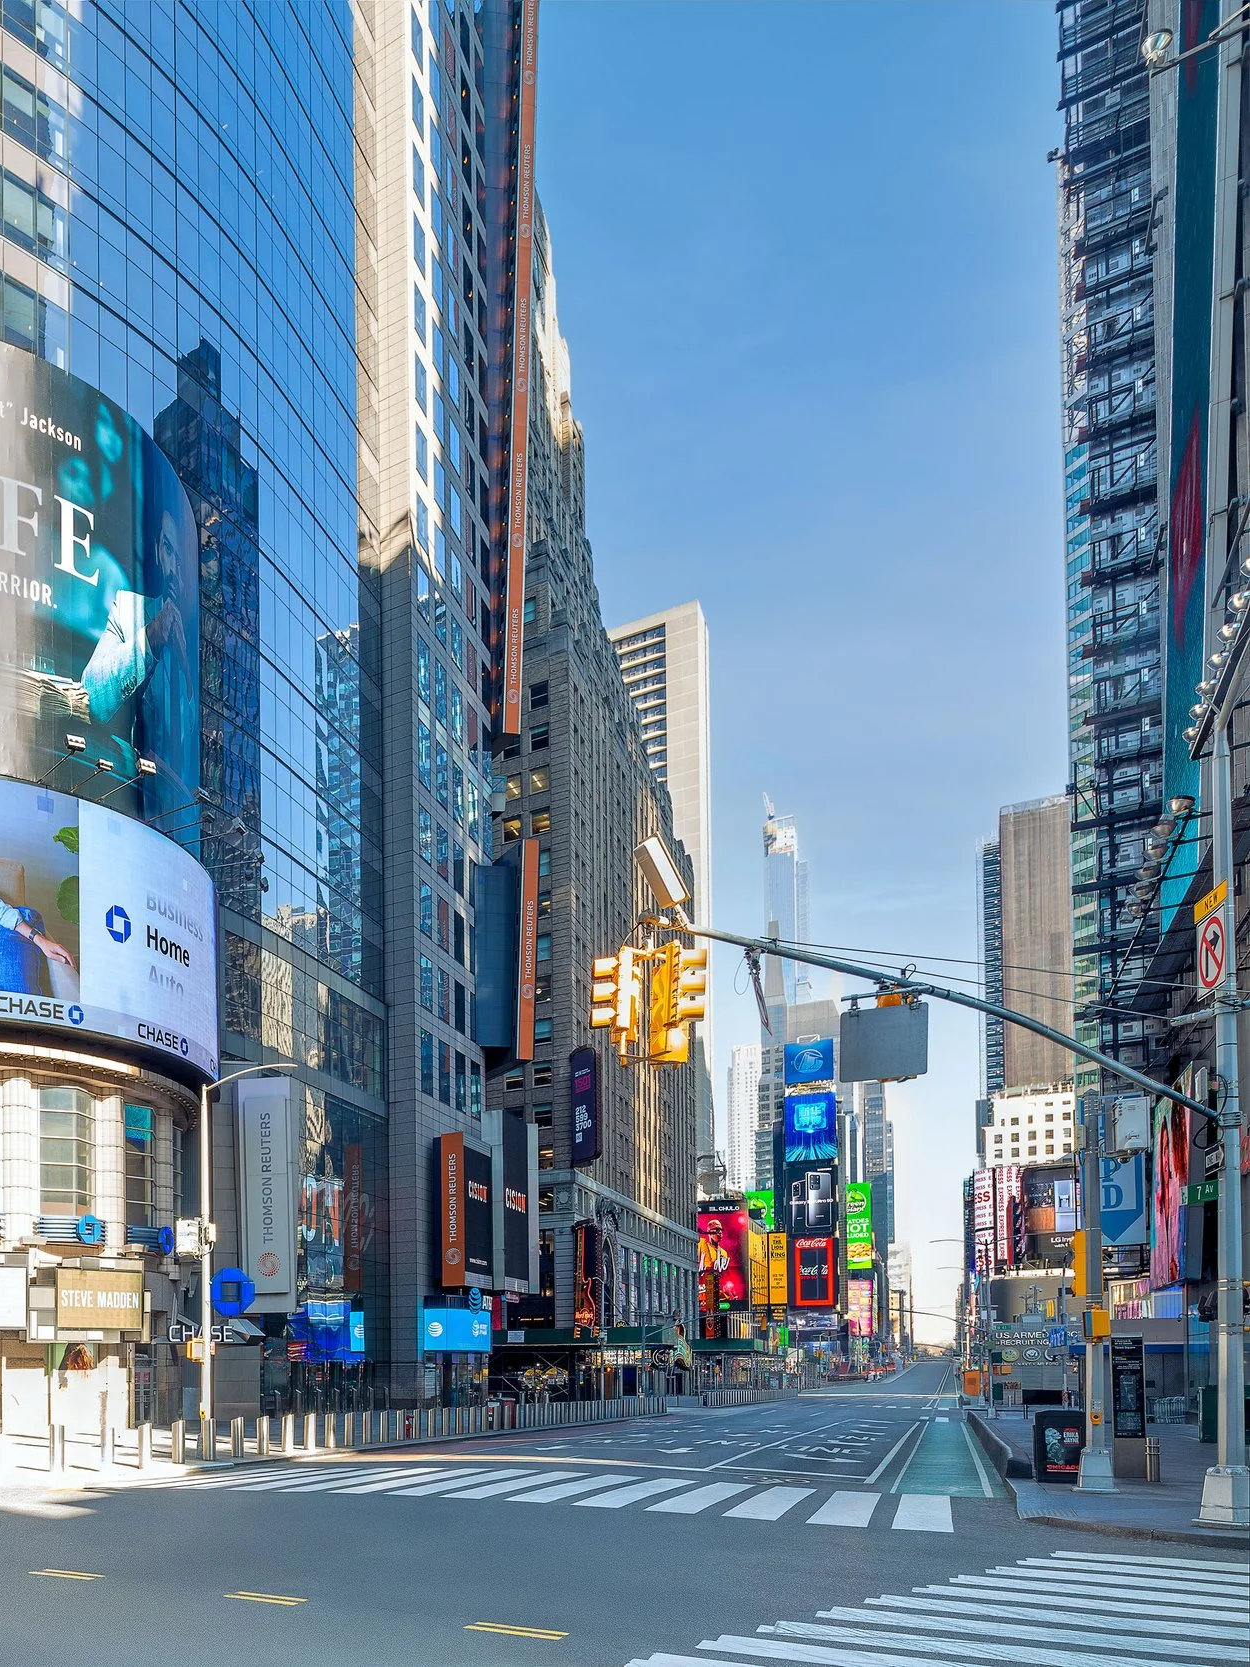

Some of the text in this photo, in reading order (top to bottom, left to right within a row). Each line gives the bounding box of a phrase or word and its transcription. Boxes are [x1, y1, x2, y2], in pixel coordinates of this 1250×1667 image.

[525, 27, 534, 66] THOMSON
[522, 143, 532, 220] THOMSON REUTERS
[518, 297, 528, 373] THOMSON REUTERS
[21, 408, 82, 452] Jackson
[514, 452, 524, 529] THOMSON REUTERS
[510, 607, 520, 685] THOMSON REUTERS
[146, 890, 204, 942] Business
[1204, 894, 1218, 912] NEW
[146, 925, 190, 967] Home
[524, 900, 534, 980] THOMSON REUTERS
[149, 965, 184, 997] Auto
[137, 1022, 179, 1051] CHASE
[575, 1104, 587, 1115] 212
[575, 1112, 588, 1123] 599
[575, 1119, 592, 1132] 3700
[261, 1112, 273, 1244] THOMSON REUTERS
[468, 1180, 488, 1203] CISION
[1197, 1184, 1214, 1200] 7 Av
[449, 1153, 457, 1243] THOMSON REUTERS
[505, 1187, 526, 1214] CISION
[770, 1251, 786, 1259] KING
[61, 1290, 139, 1309] STEVE MADDEN
